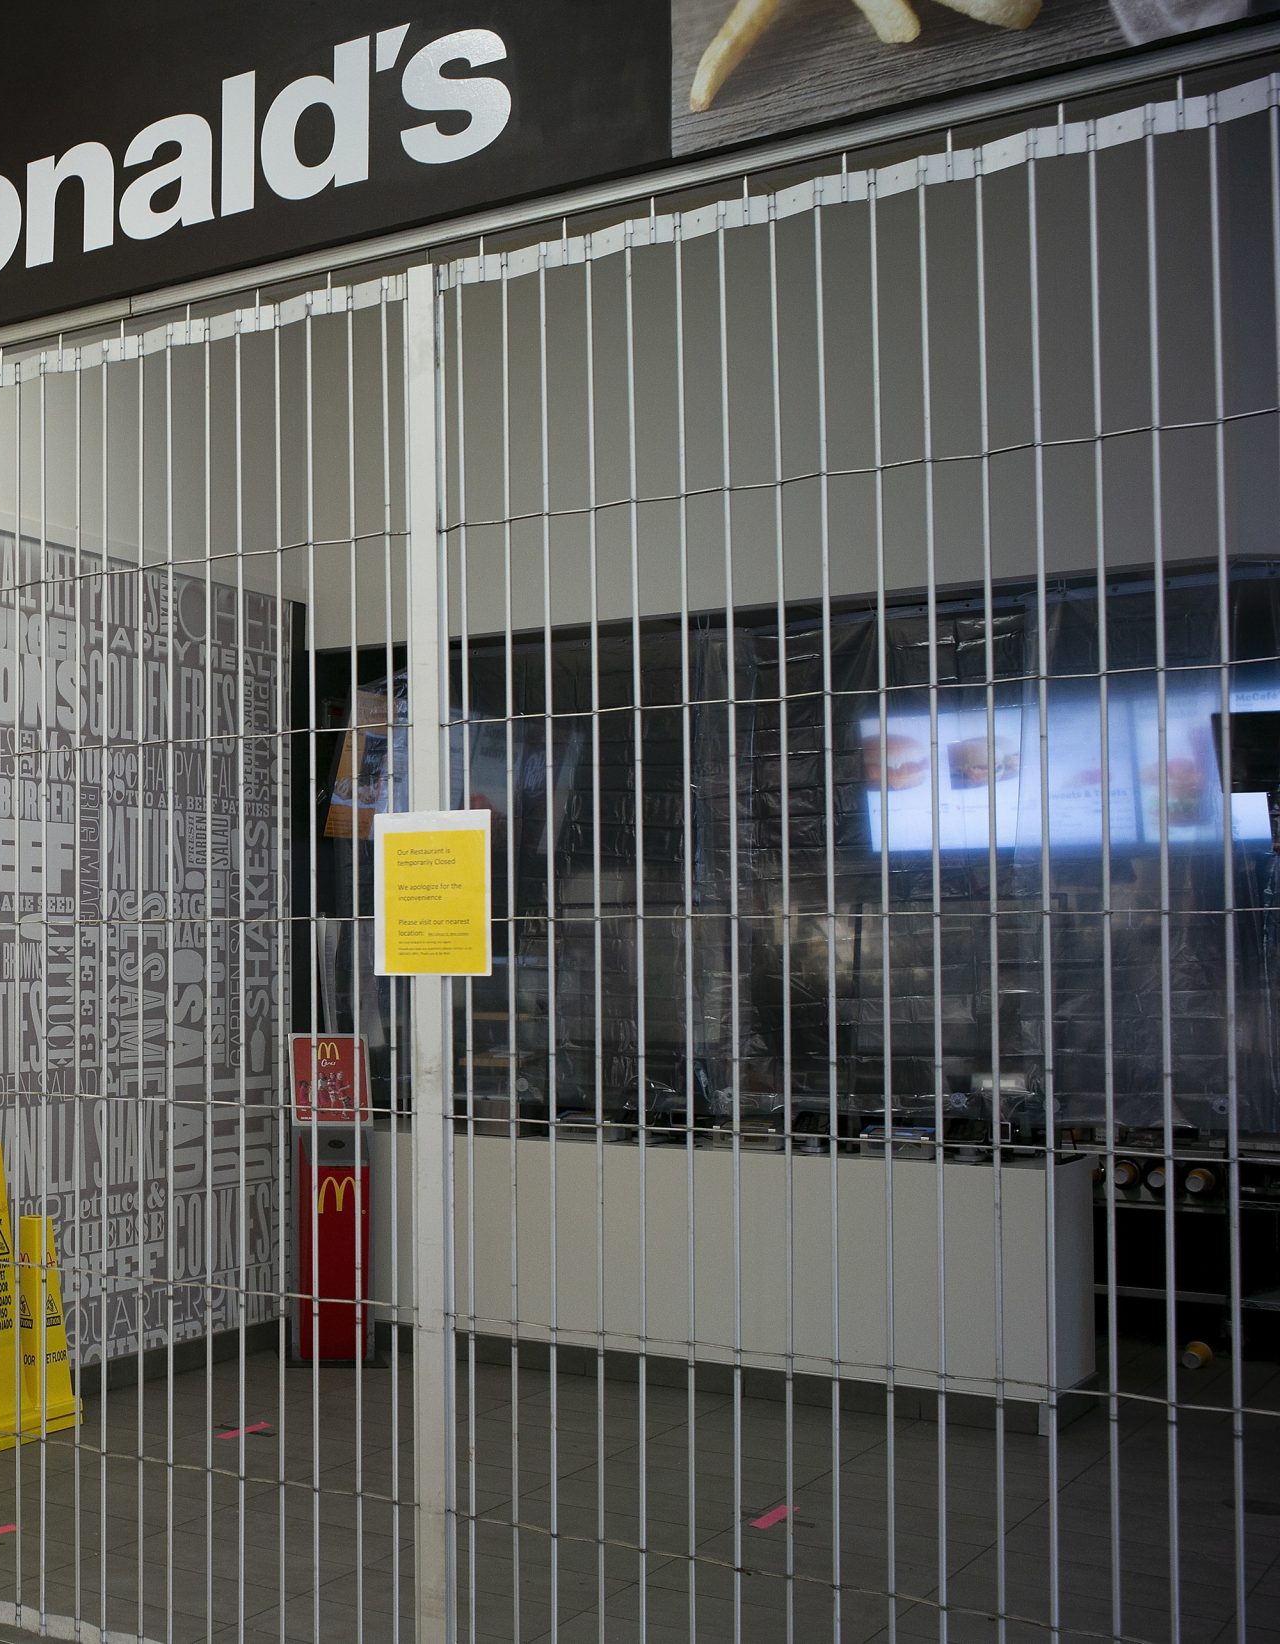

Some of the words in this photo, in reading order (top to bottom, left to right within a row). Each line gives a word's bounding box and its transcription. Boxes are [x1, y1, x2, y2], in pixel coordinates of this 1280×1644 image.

[89, 621, 192, 662] HAPPY
[199, 643, 272, 677] MEAL
[89, 650, 170, 745] GOLDEN
[179, 667, 235, 755] FRES
[145, 747, 195, 794] HAPY
[158, 793, 183, 811] AL
[222, 798, 271, 819] PATIES
[100, 804, 185, 893] PATTIES
[434, 858, 455, 866] Closed
[245, 818, 270, 1018] SHAKES
[419, 918, 432, 926] visit
[3, 942, 44, 981] BRWNS
[120, 891, 165, 1093] SESAME
[63, 1190, 142, 1223] Letuce
[52, 1350, 67, 1362] FLOOR
